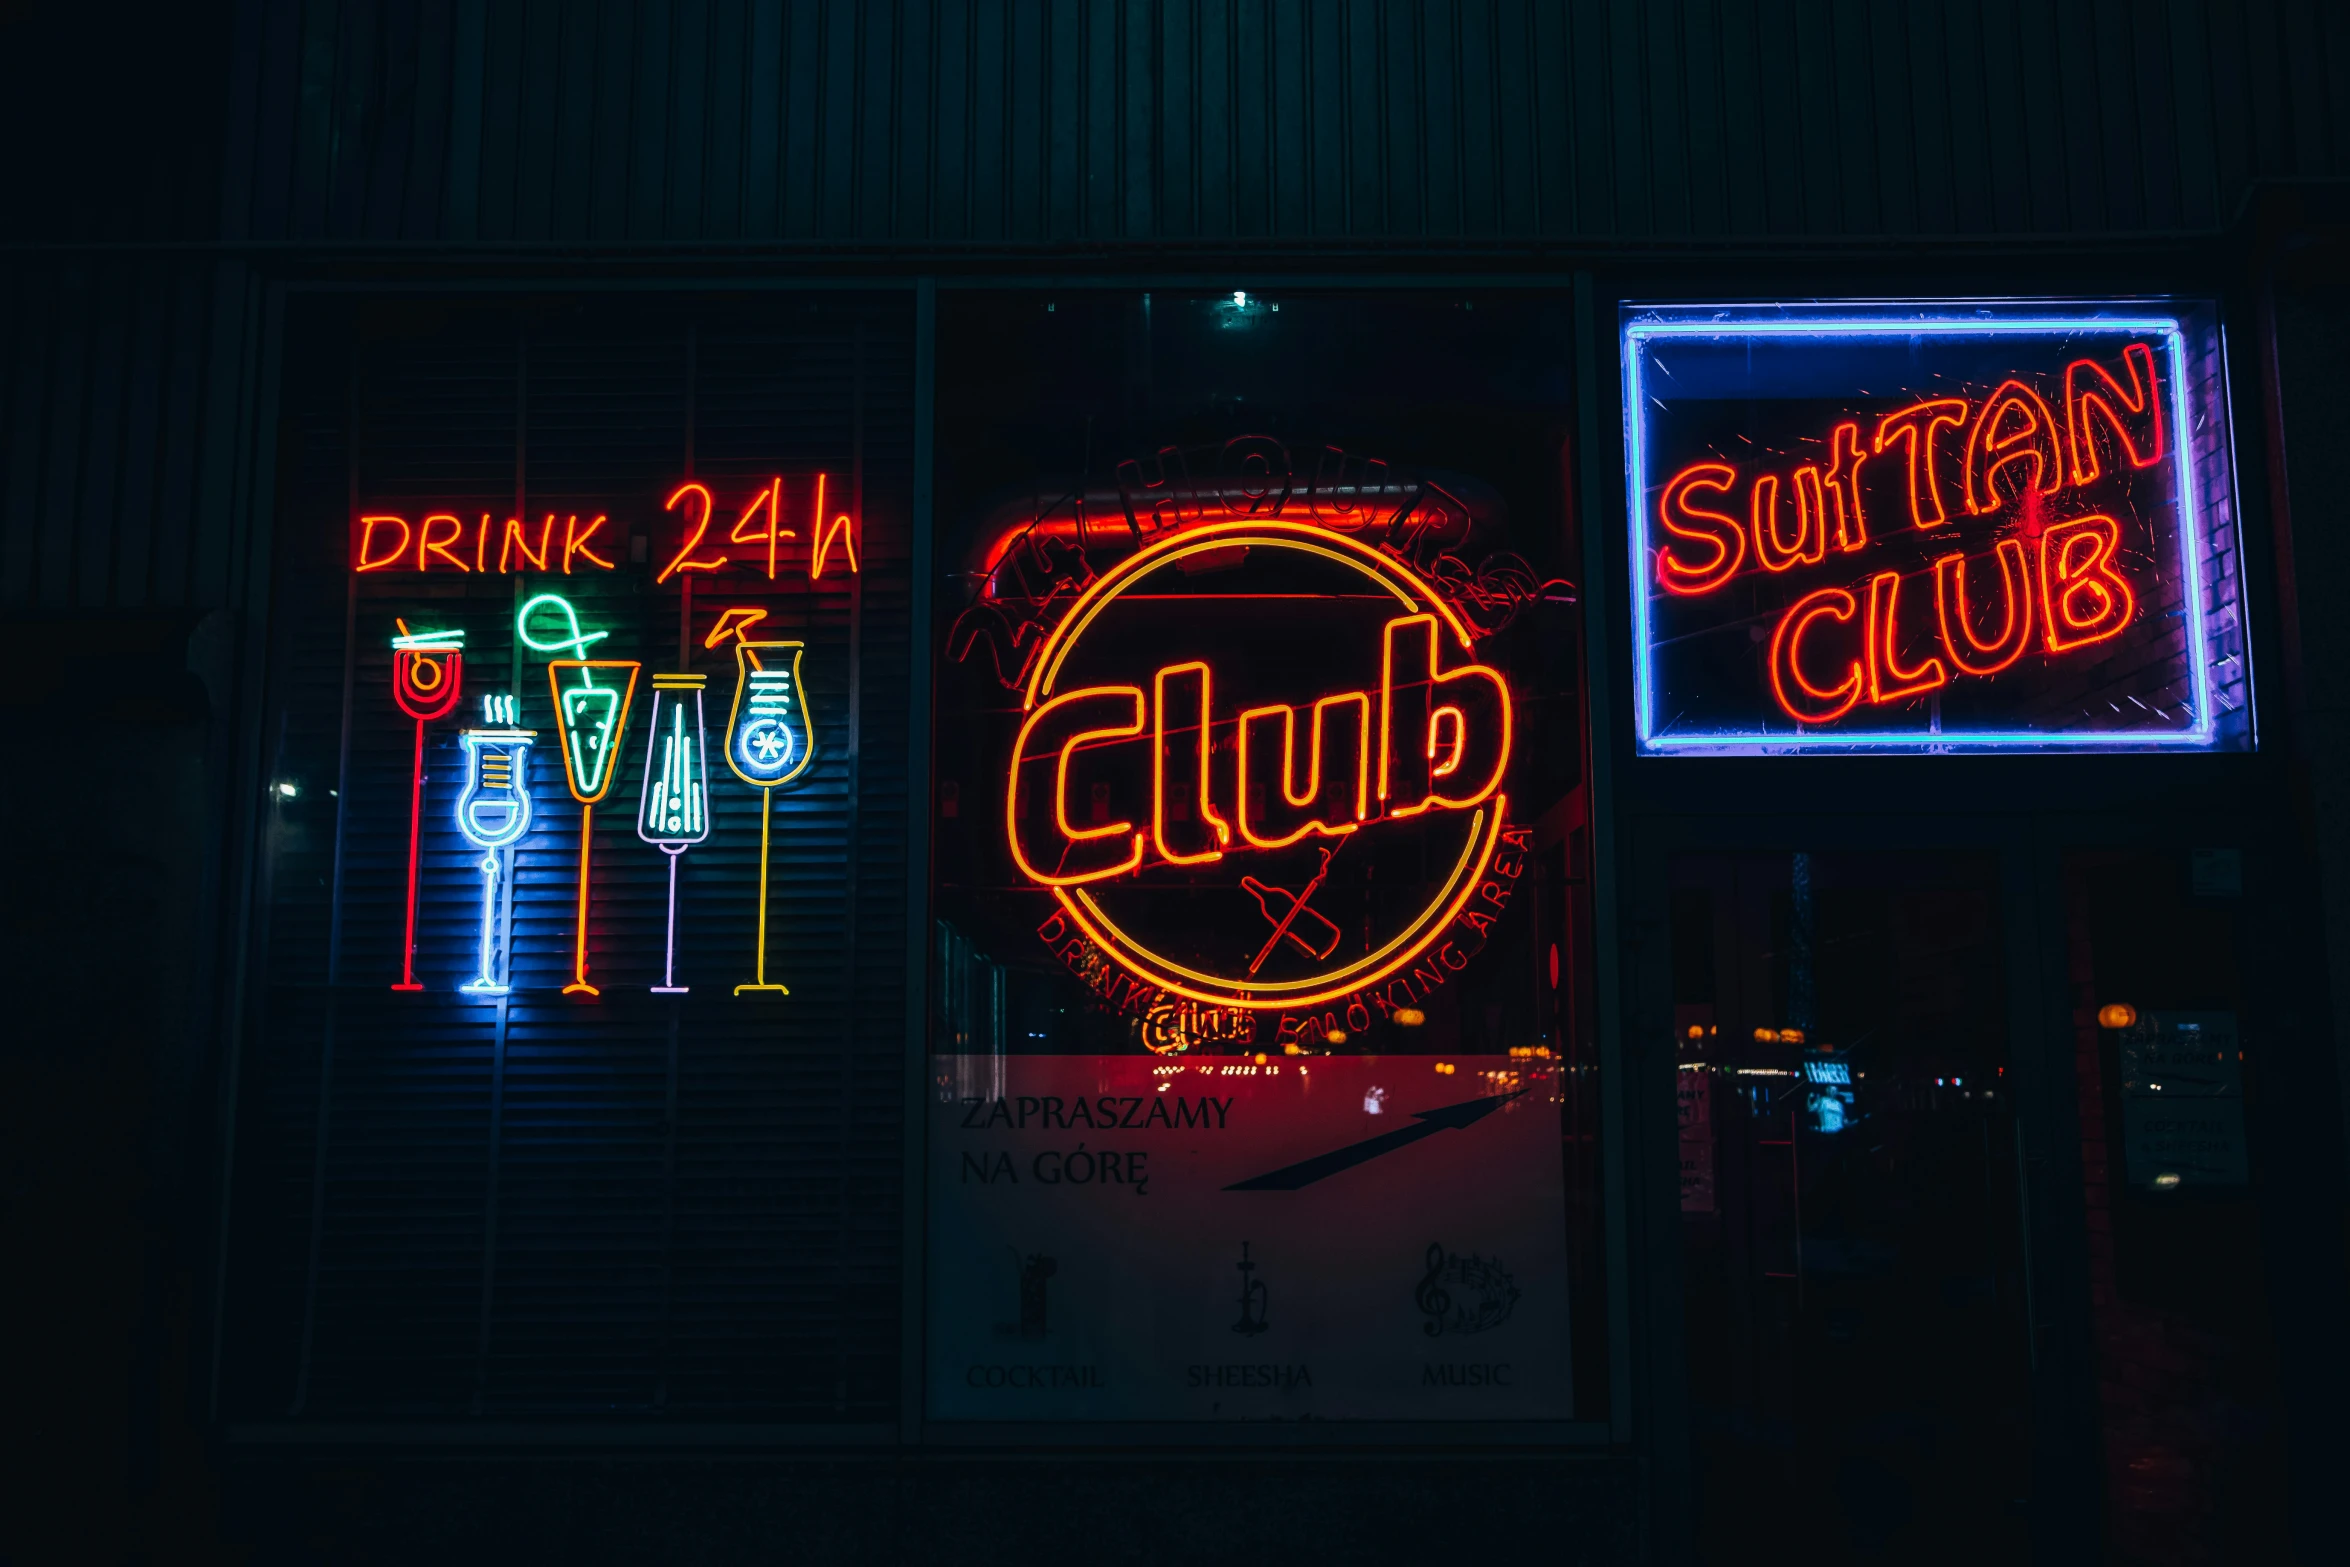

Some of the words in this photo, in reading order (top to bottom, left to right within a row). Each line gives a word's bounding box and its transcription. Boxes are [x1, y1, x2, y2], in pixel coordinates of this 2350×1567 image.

[355, 513, 615, 574] DRINK
[1770, 514, 2135, 724] CLUB
[1007, 613, 1511, 885] Club
[1274, 941, 1468, 1047] SMOKING
[1466, 828, 1533, 939] AREA
[960, 1097, 1235, 1130] ZAPRASZAMY
[961, 1151, 1018, 1184] NA
[1033, 1142, 1150, 1195] GÓRĘ
[966, 1365, 1105, 1388] COCKTAIL
[1187, 1364, 1313, 1388] SHEESHA
[1422, 1364, 1512, 1387] MUSIC
